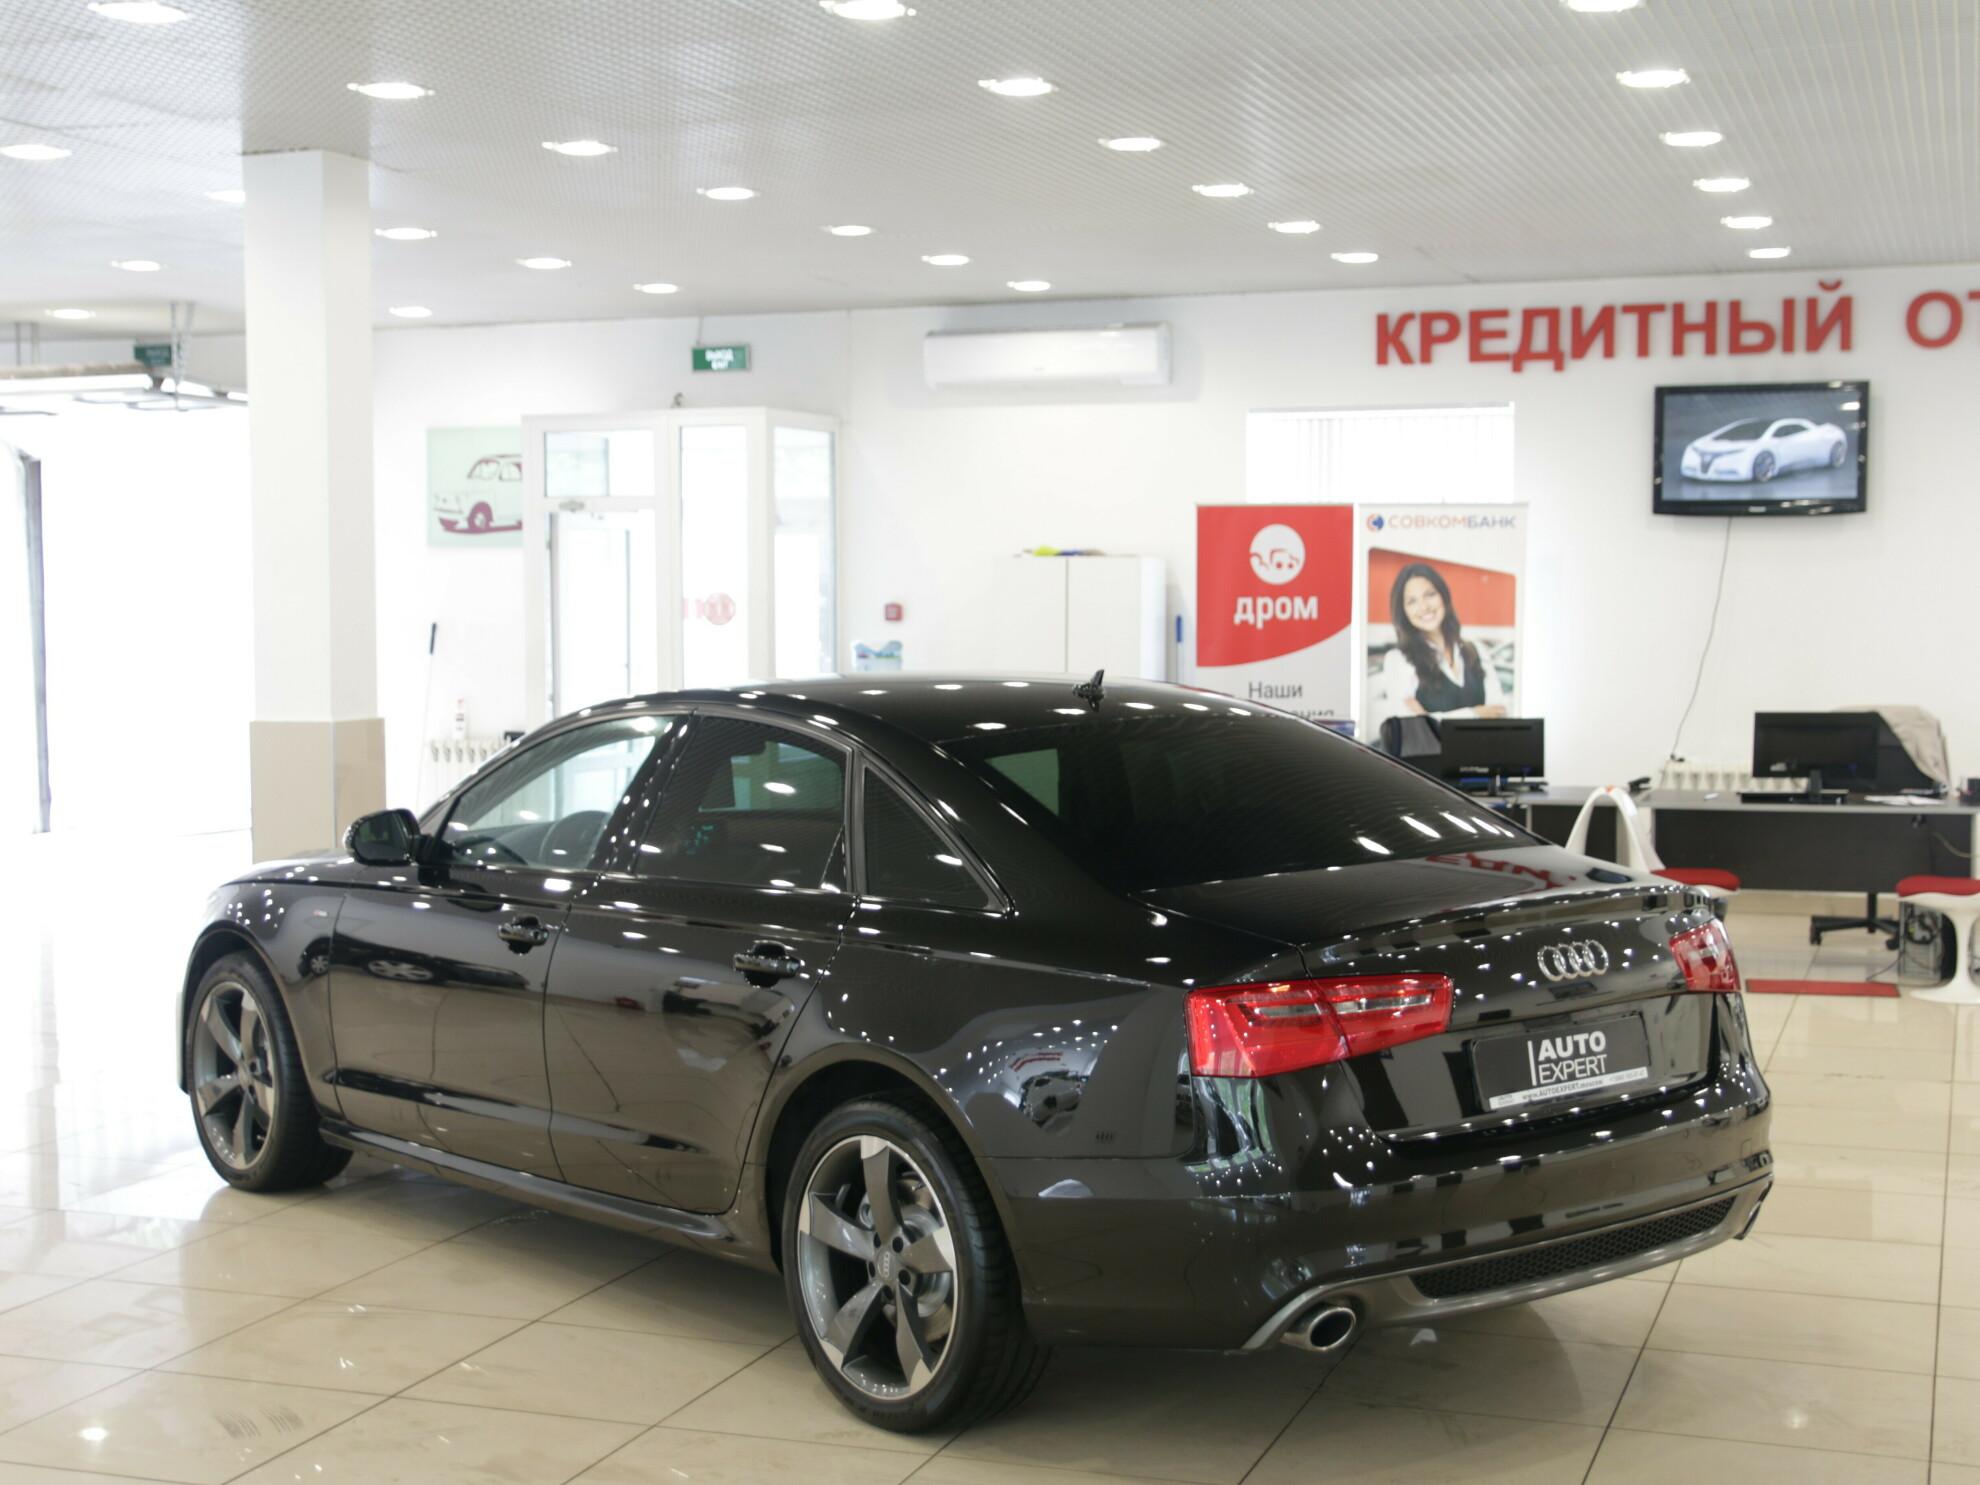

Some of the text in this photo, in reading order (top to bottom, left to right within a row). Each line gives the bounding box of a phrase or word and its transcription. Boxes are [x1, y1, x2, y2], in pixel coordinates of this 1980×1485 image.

[1375, 279, 1980, 373] КРЕДИТНЫЙ О
[1388, 514, 1516, 530] СОВКОМБАНК
[1233, 596, 1318, 630] дром
[1248, 681, 1303, 699] Наши
[1538, 1031, 1607, 1061] AUTO
[1538, 1054, 1608, 1084] EXPERT
